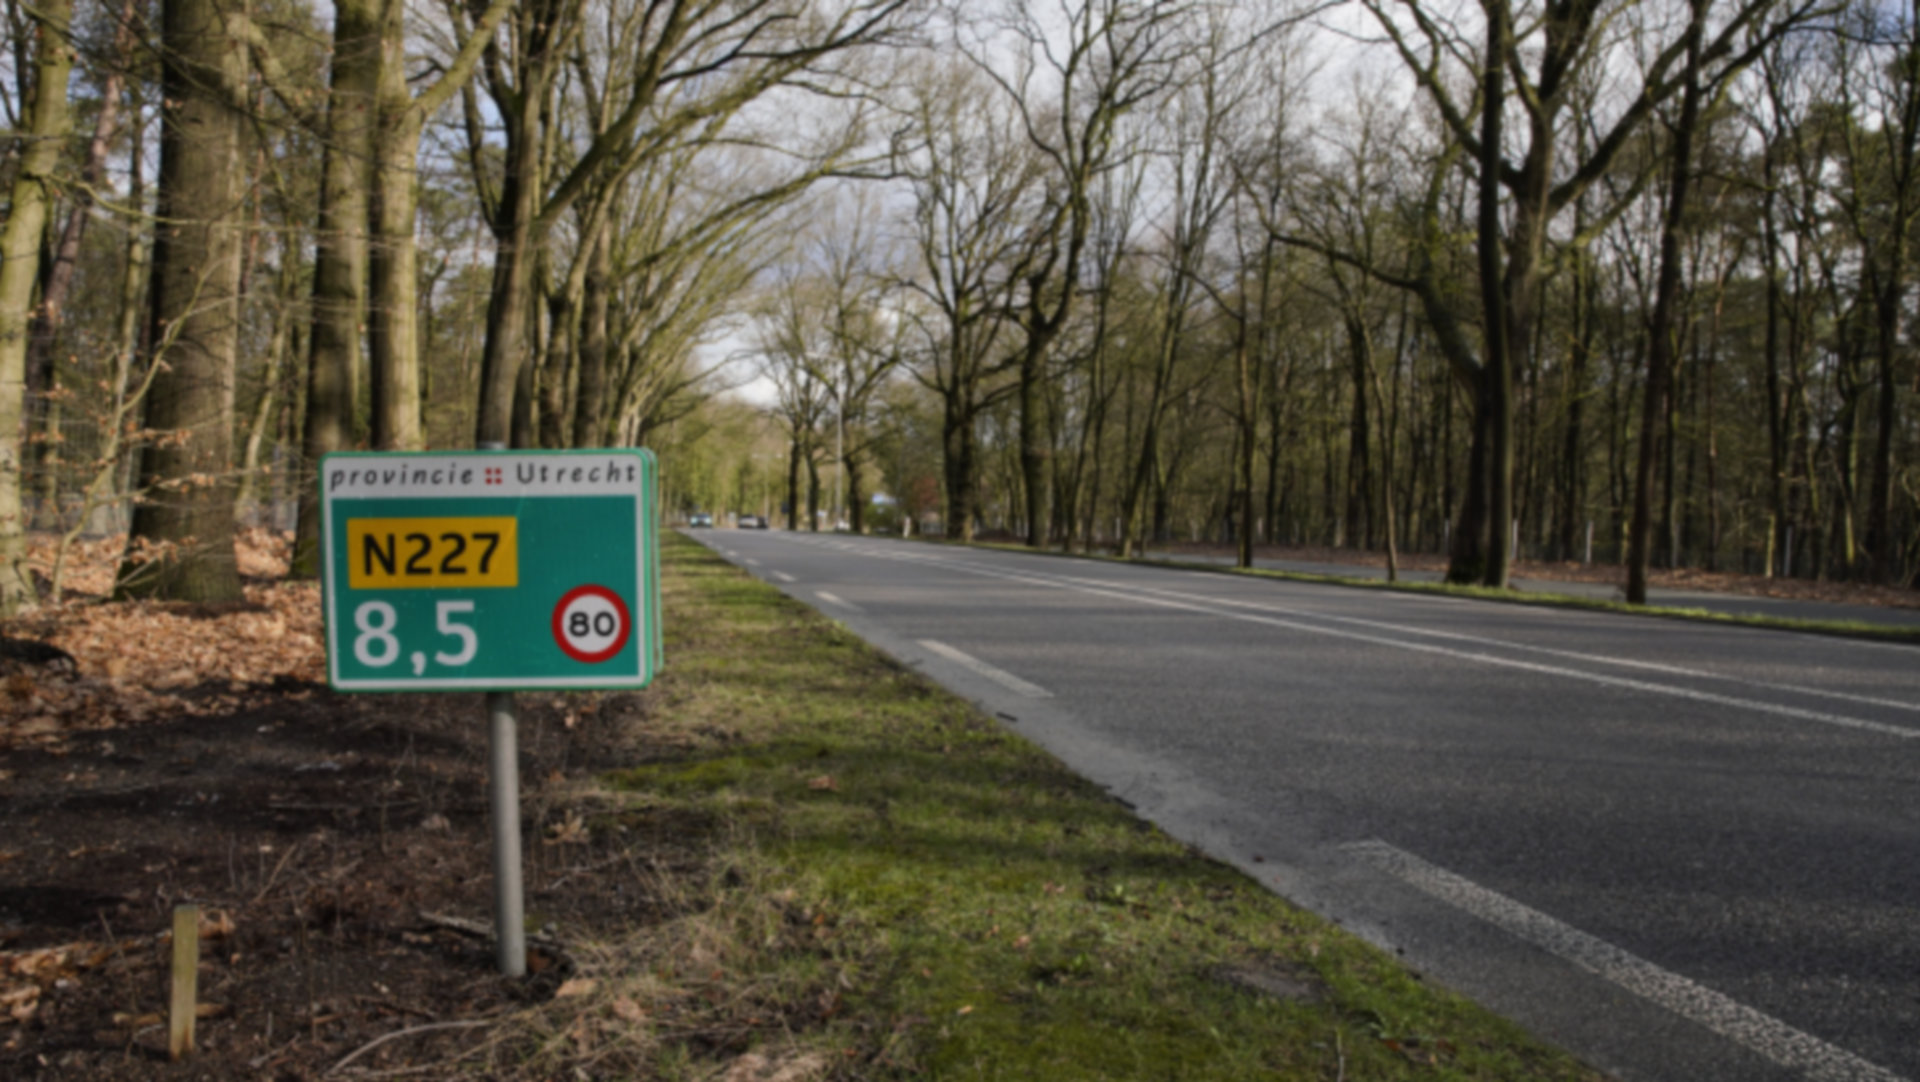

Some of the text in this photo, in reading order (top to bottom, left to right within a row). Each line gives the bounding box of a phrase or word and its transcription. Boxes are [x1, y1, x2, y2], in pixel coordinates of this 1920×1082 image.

[329, 460, 636, 491] provincie Utrecht
[362, 532, 500, 576] N227
[353, 599, 478, 676] 8,5
[568, 611, 616, 637] 80
